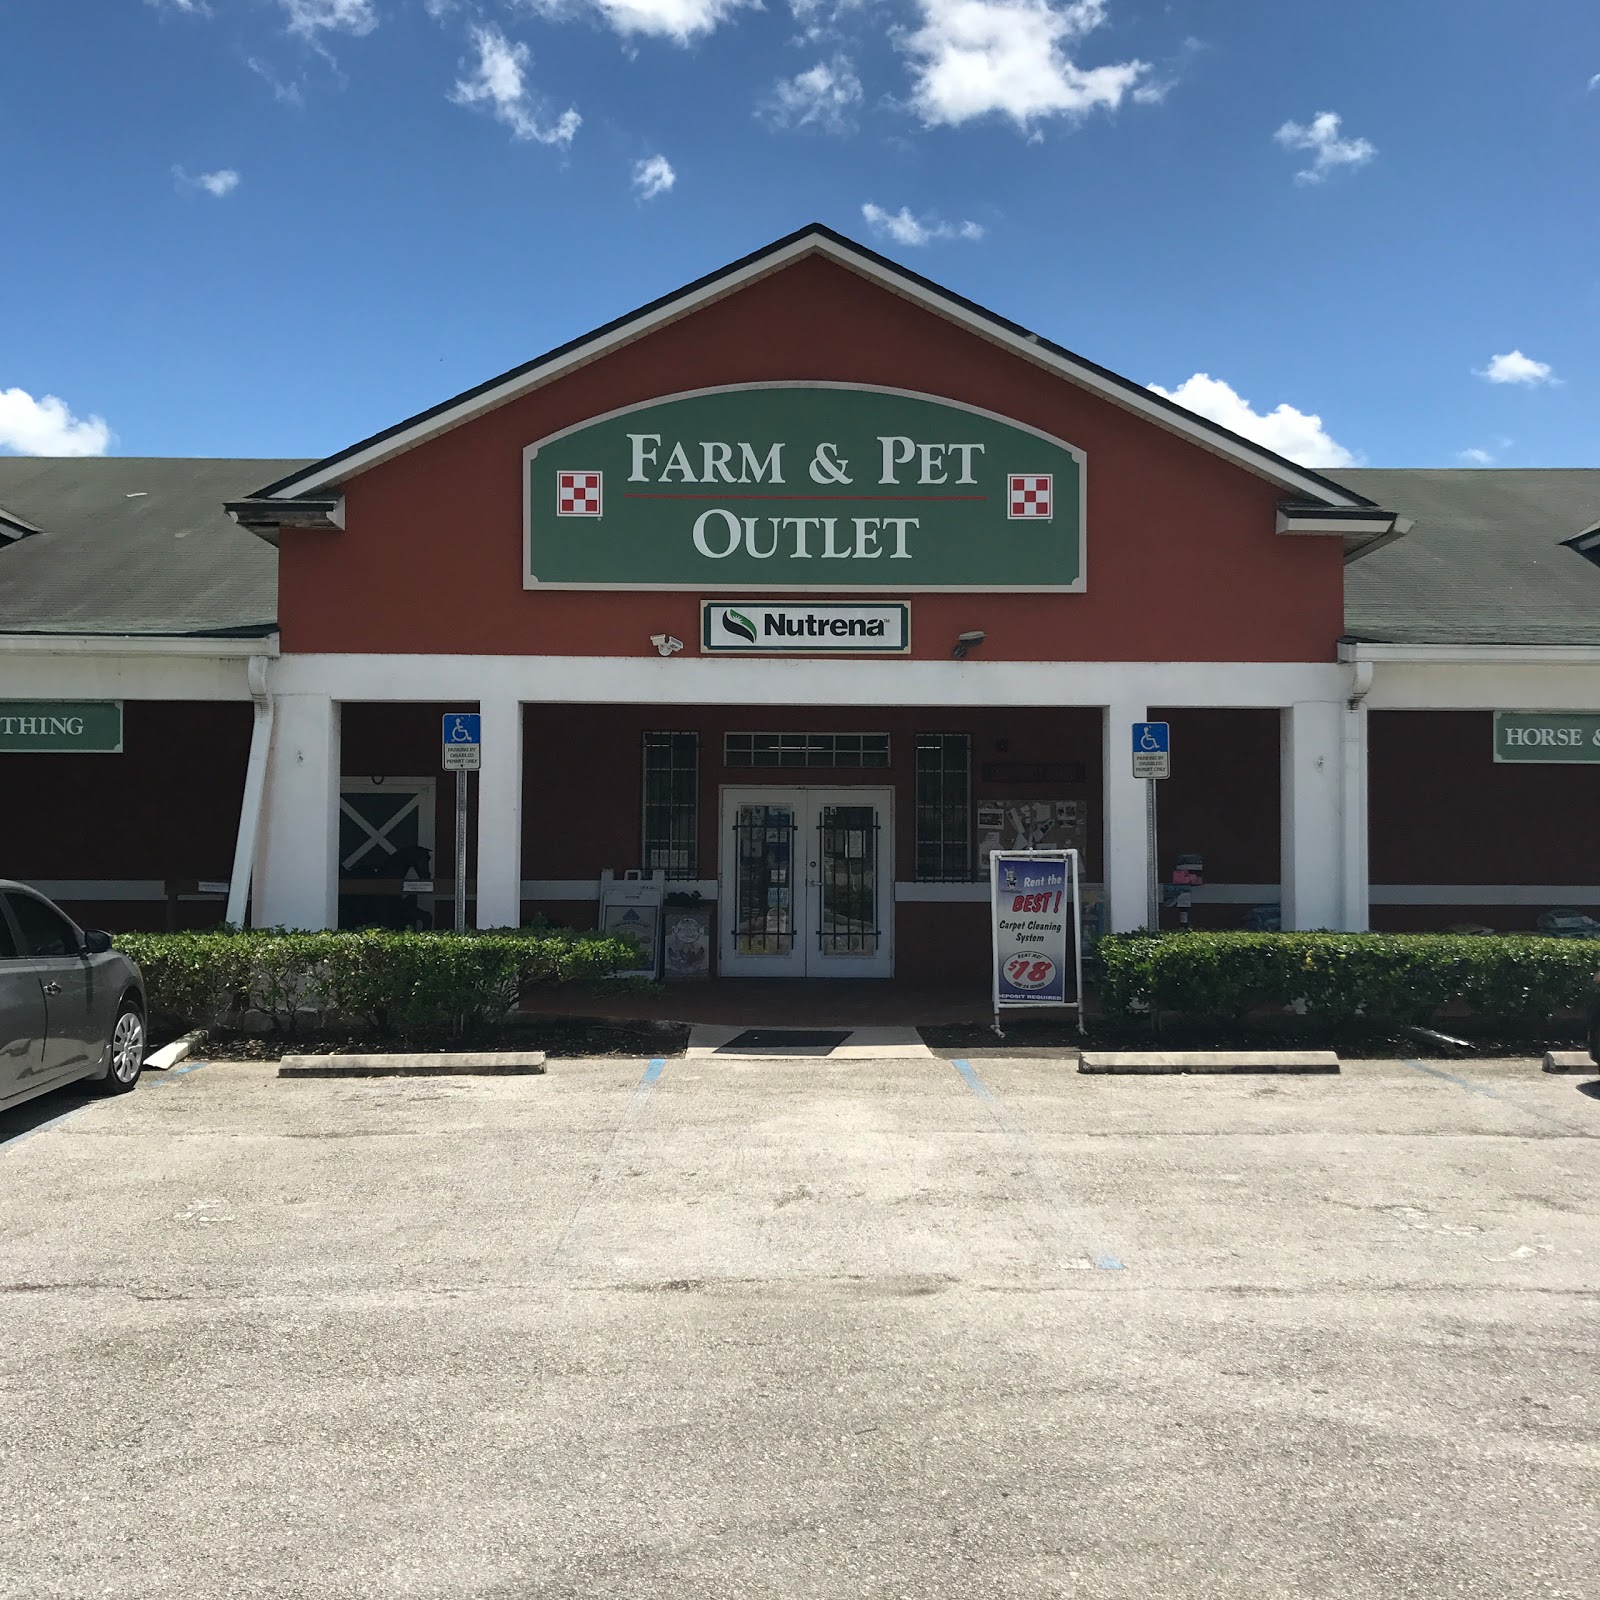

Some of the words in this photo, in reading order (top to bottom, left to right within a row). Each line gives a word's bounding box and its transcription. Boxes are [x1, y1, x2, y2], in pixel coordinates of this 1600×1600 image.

[626, 433, 785, 484] FARM
[809, 442, 853, 485] &
[877, 435, 985, 486] PET
[692, 508, 919, 559] OUTLET
[764, 613, 884, 636] Nutrena
[1504, 728, 1583, 746] HORSE
[1023, 876, 1046, 888] Rent
[1047, 873, 1062, 885] the
[999, 920, 1026, 932] Carpet
[1027, 920, 1062, 934] Cleaning
[1015, 932, 1045, 944] System
[1007, 959, 1053, 982] $18
